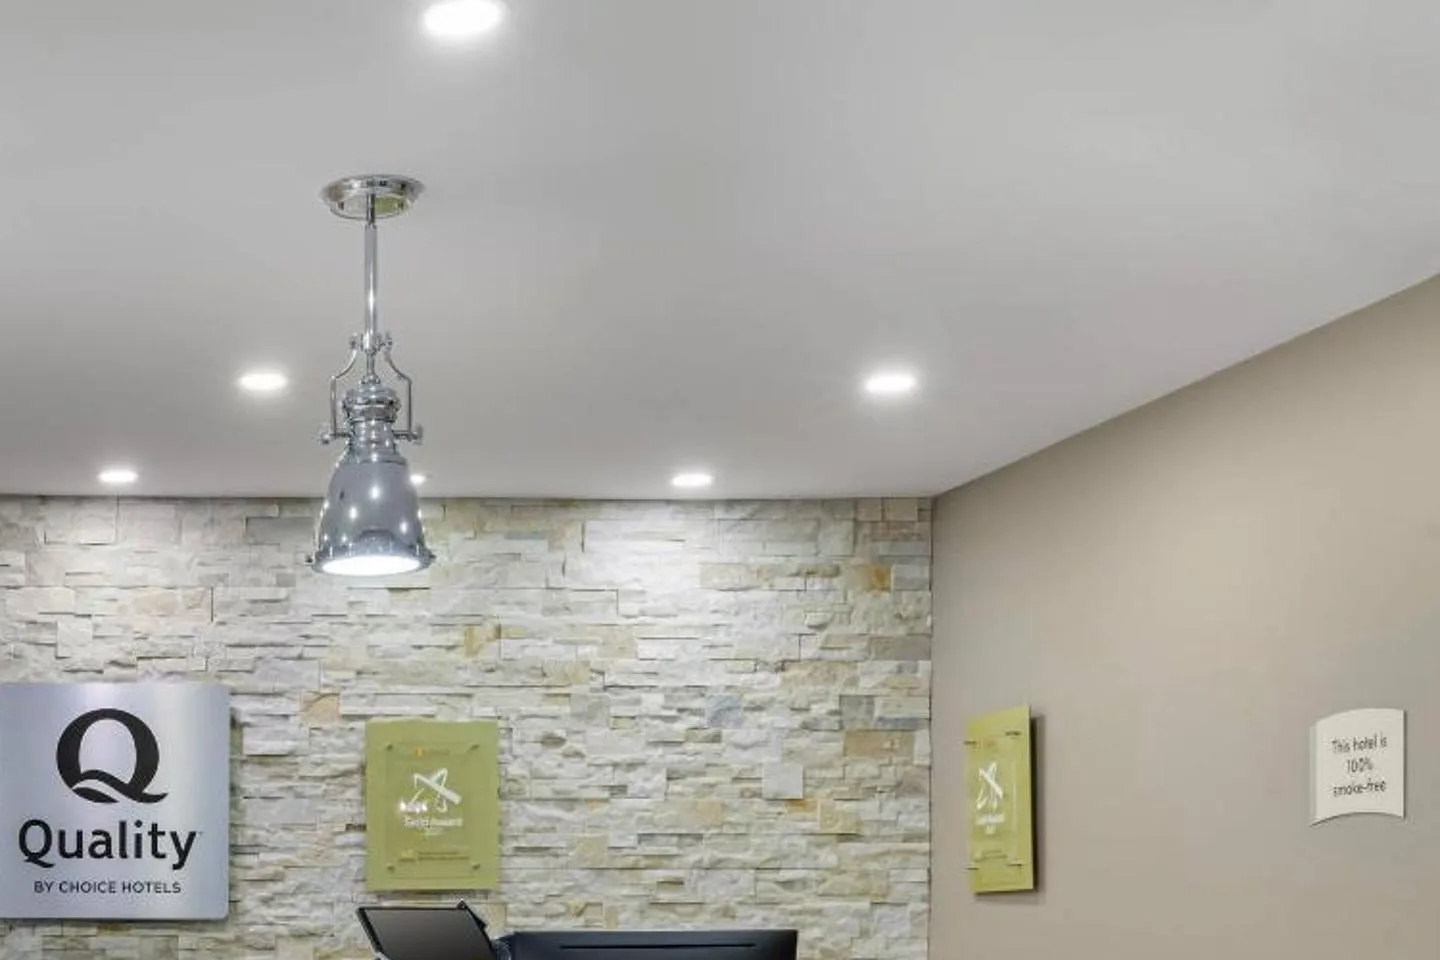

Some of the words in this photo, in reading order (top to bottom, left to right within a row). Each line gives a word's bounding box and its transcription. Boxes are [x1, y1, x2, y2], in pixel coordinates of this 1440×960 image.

[55, 708, 168, 804] Q
[18, 819, 197, 871] Quality
[33, 881, 53, 894] BY
[59, 881, 116, 894] CHOICE
[122, 881, 181, 894] HOTELS
